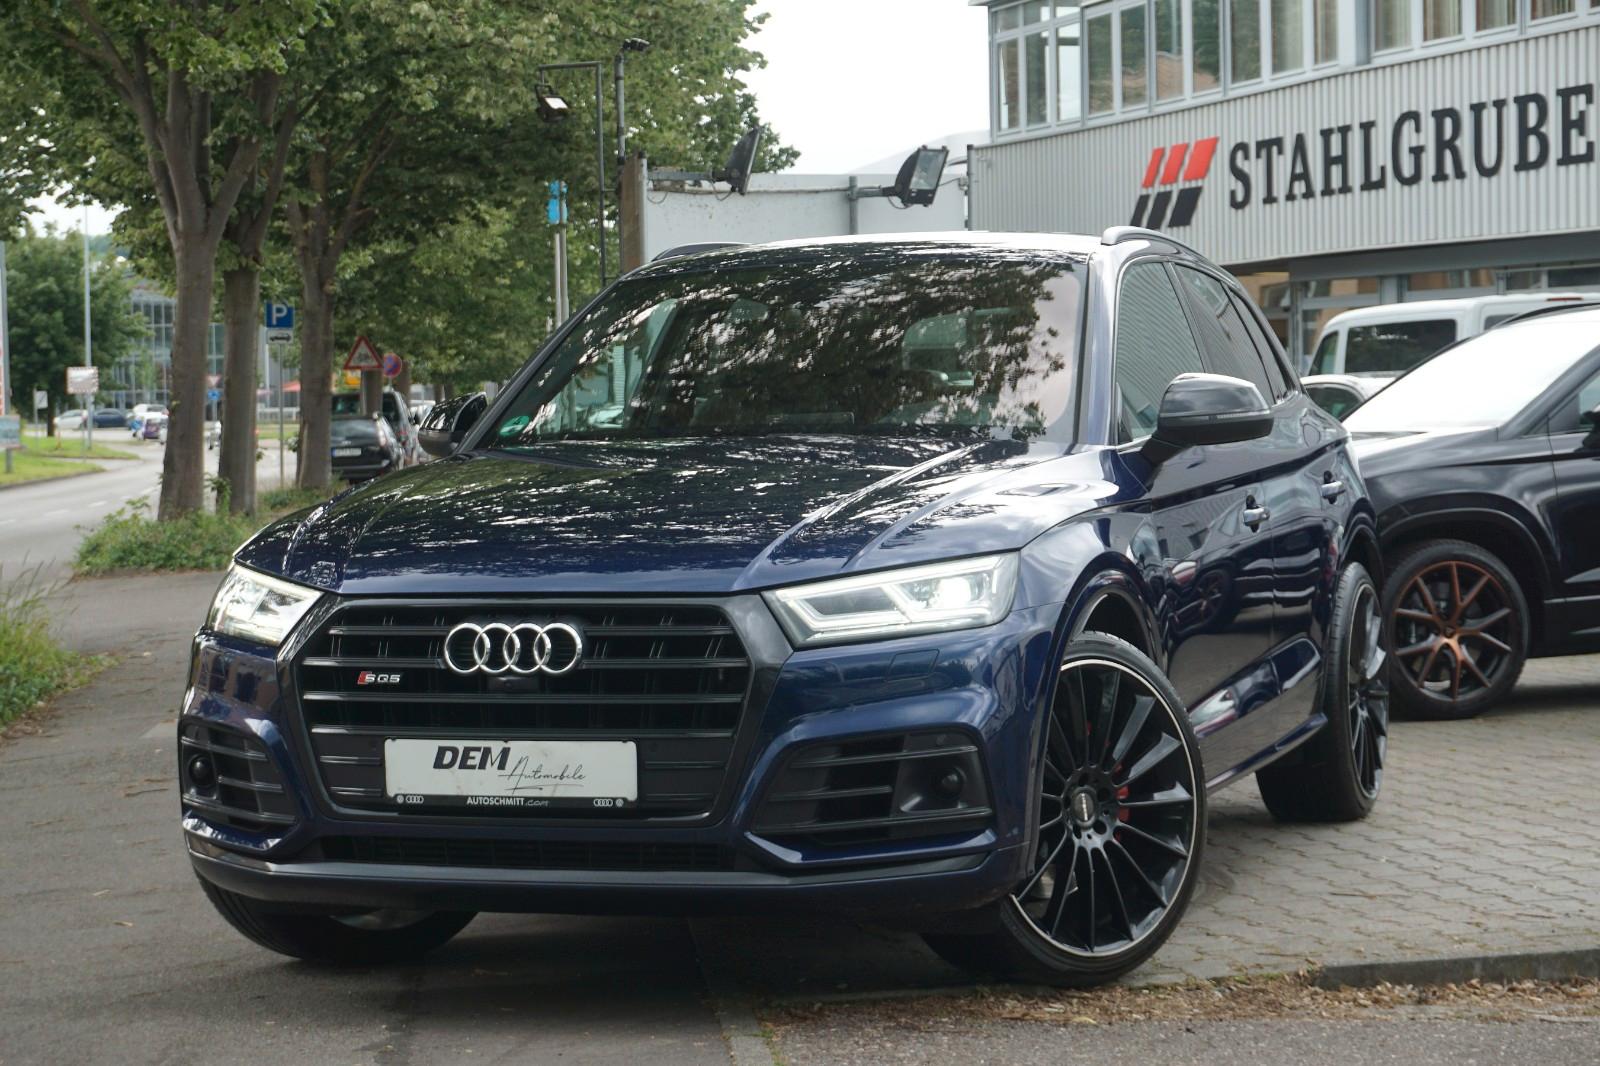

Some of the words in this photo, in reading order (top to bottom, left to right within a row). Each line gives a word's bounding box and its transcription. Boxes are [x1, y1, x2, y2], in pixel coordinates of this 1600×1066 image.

[1229, 83, 1596, 211] STAHLGRUBE
[272, 303, 288, 325] P
[364, 673, 401, 683] SQ5
[432, 745, 511, 771] DEM
[498, 756, 586, 792] Automobile
[466, 796, 549, 807] AUTOSCHMITT.com
